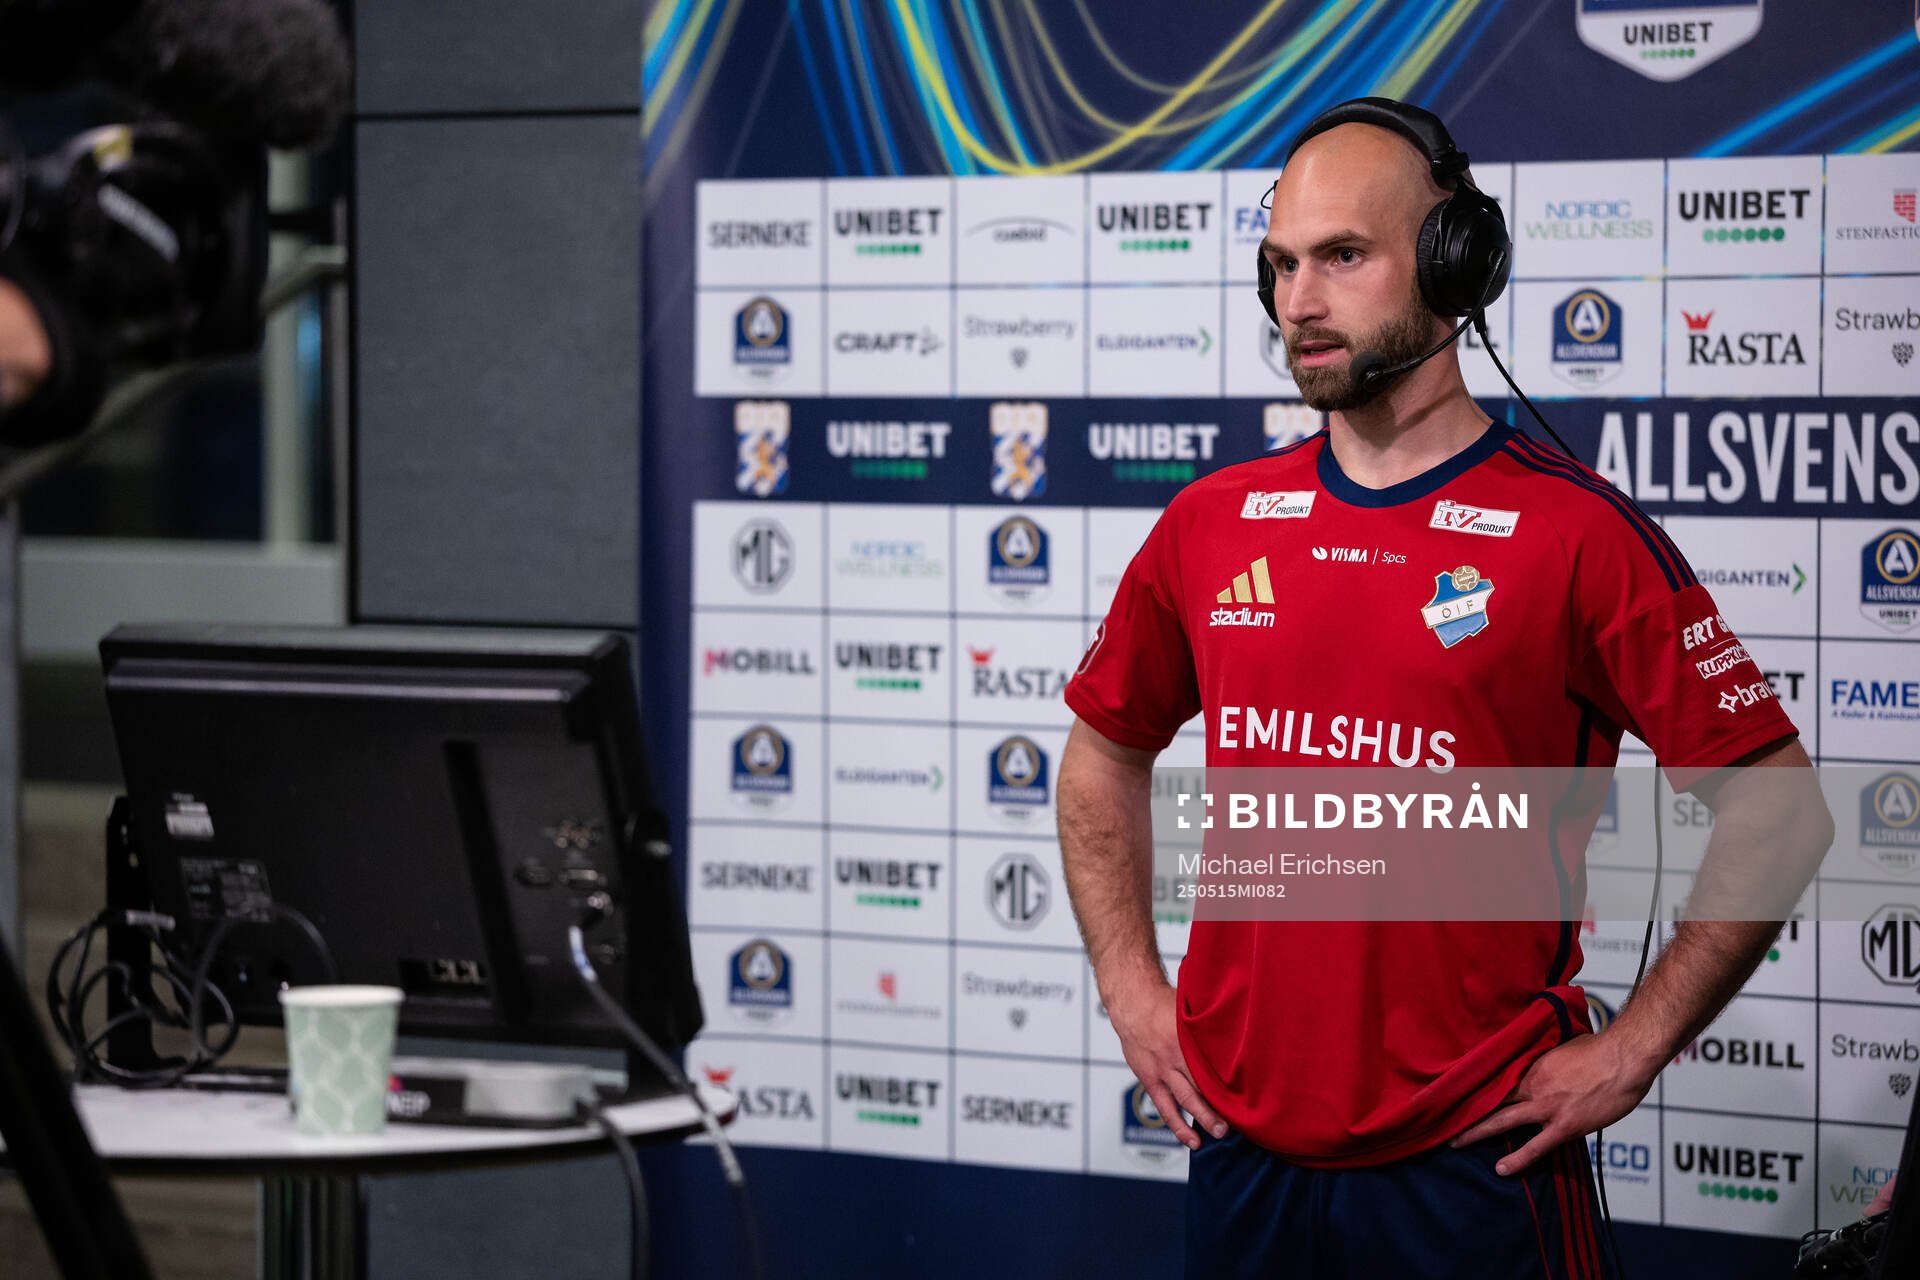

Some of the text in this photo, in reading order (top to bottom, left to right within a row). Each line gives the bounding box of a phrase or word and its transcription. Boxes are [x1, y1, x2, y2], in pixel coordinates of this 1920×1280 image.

[1623, 22, 1712, 46] UNIBET
[1099, 204, 1211, 231] UNIBET
[1545, 201, 1631, 219] NORDIC
[1678, 189, 1810, 220] UNIBET
[709, 220, 809, 247] SERNEKE
[835, 209, 941, 235] UNIBET
[1525, 220, 1653, 241] WELLNESS
[1836, 308, 1920, 331] Strawb
[834, 333, 917, 353] CRAFT
[1687, 333, 1807, 366] RASTA
[826, 421, 951, 458] UNIBET
[1088, 424, 1219, 460] UNIBET
[1471, 522, 1512, 535] PRODUKT
[1331, 548, 1407, 565] VISMA Spcs
[1209, 607, 1275, 627] stadium
[705, 650, 814, 674] MOBILL
[836, 643, 941, 671] UNIBET
[1832, 680, 1920, 707] FAME
[1219, 706, 1457, 774] EMILSHUS
[703, 864, 813, 891] SERNEKE
[836, 858, 941, 888] UNIBET
[994, 863, 1048, 921] MG
[1832, 1034, 1919, 1062] Strawb
[737, 1086, 815, 1121] ASTA
[836, 1074, 941, 1107] UNIBET
[963, 1096, 1073, 1128] SERNEKE
[1674, 1143, 1804, 1183] UNIBET
